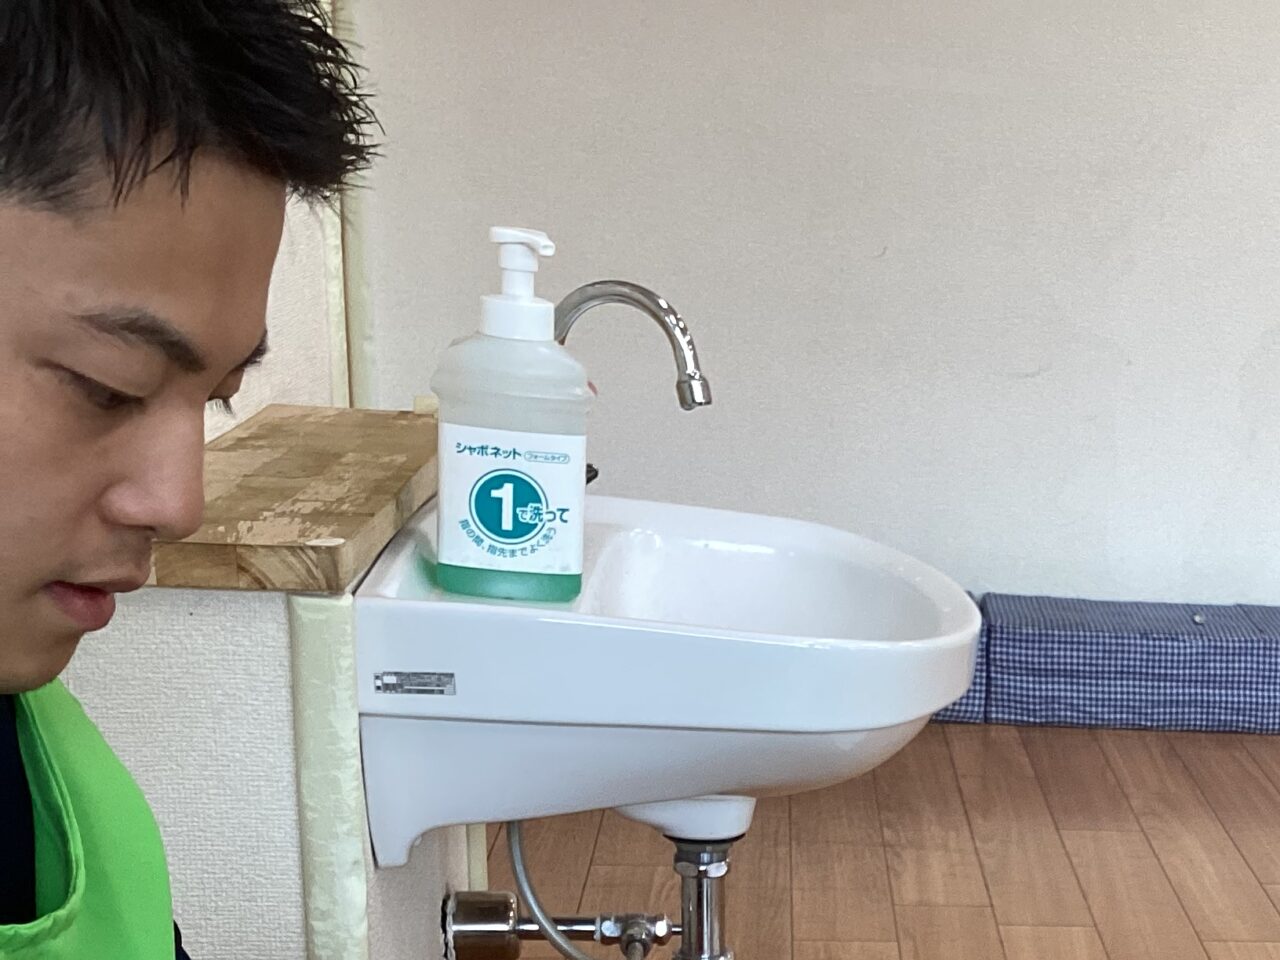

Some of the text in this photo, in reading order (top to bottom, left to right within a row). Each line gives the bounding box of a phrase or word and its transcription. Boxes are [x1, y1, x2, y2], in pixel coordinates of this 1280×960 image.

[455, 442, 521, 460] シャボネット
